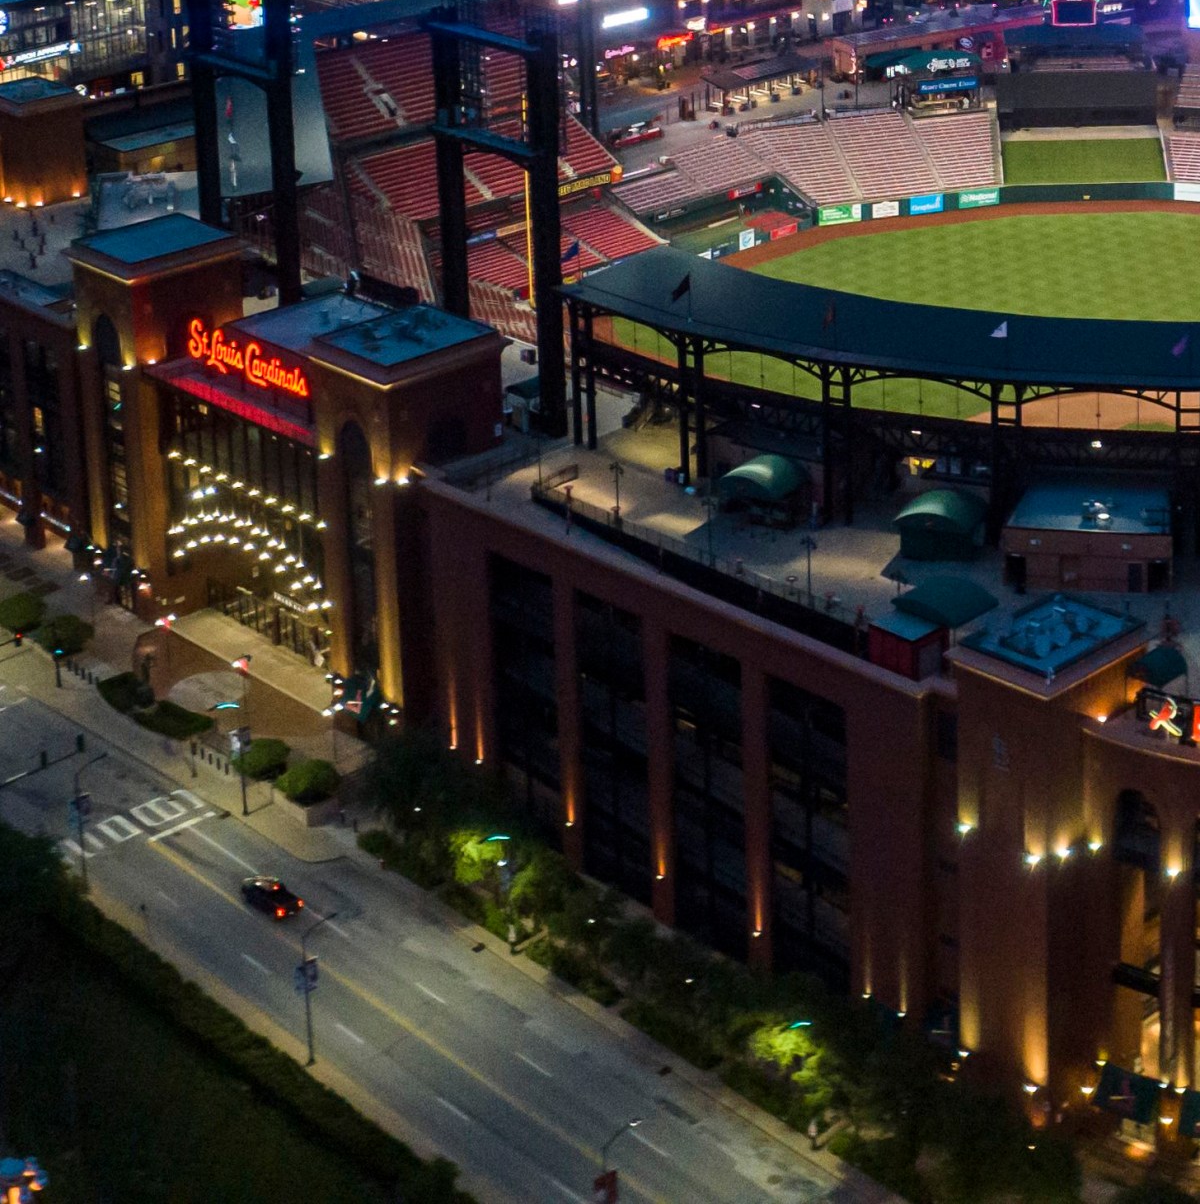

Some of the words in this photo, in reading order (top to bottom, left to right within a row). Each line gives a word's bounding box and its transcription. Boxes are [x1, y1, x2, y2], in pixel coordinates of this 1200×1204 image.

[189, 319, 211, 359] St.
[206, 329, 244, 374] Louis
[245, 342, 308, 397] Cardinals
